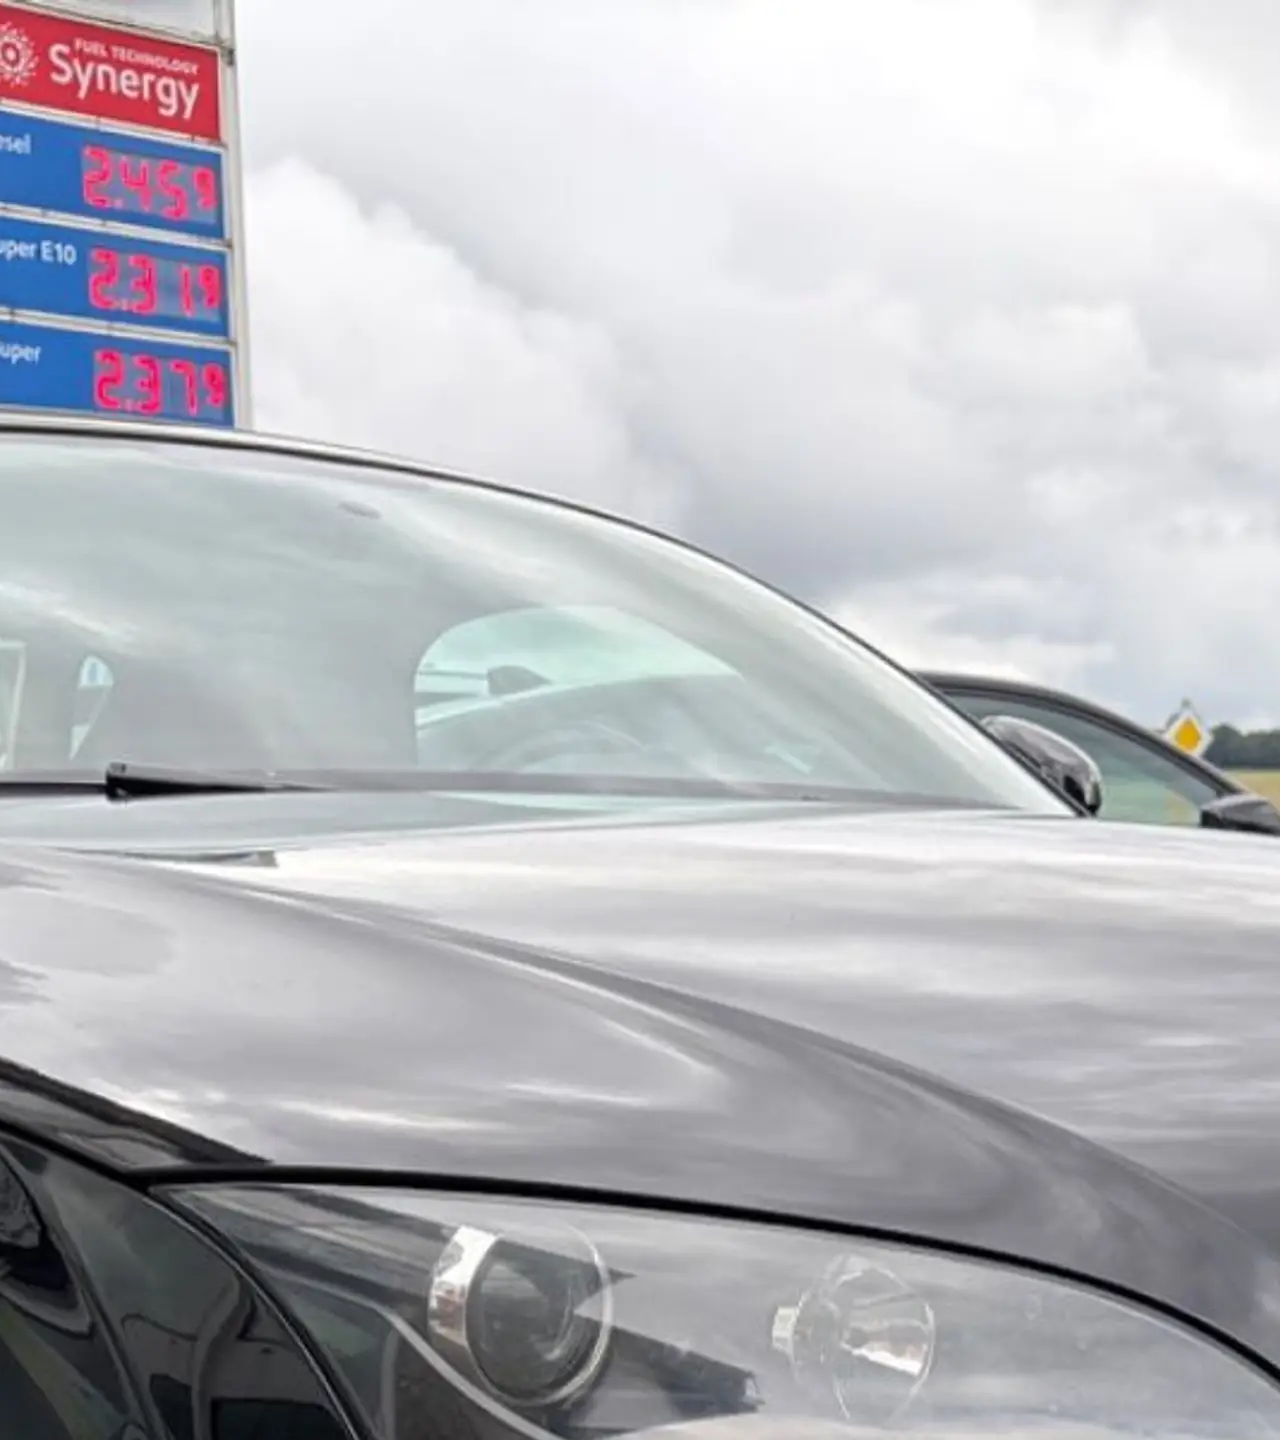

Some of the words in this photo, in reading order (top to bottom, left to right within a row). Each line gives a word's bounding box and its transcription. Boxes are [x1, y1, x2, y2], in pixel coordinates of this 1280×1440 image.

[75, 37, 109, 58] FUEL
[111, 43, 200, 75] TECHNOLOGY
[48, 43, 200, 119] Synergy
[41, 237, 77, 266] E10
